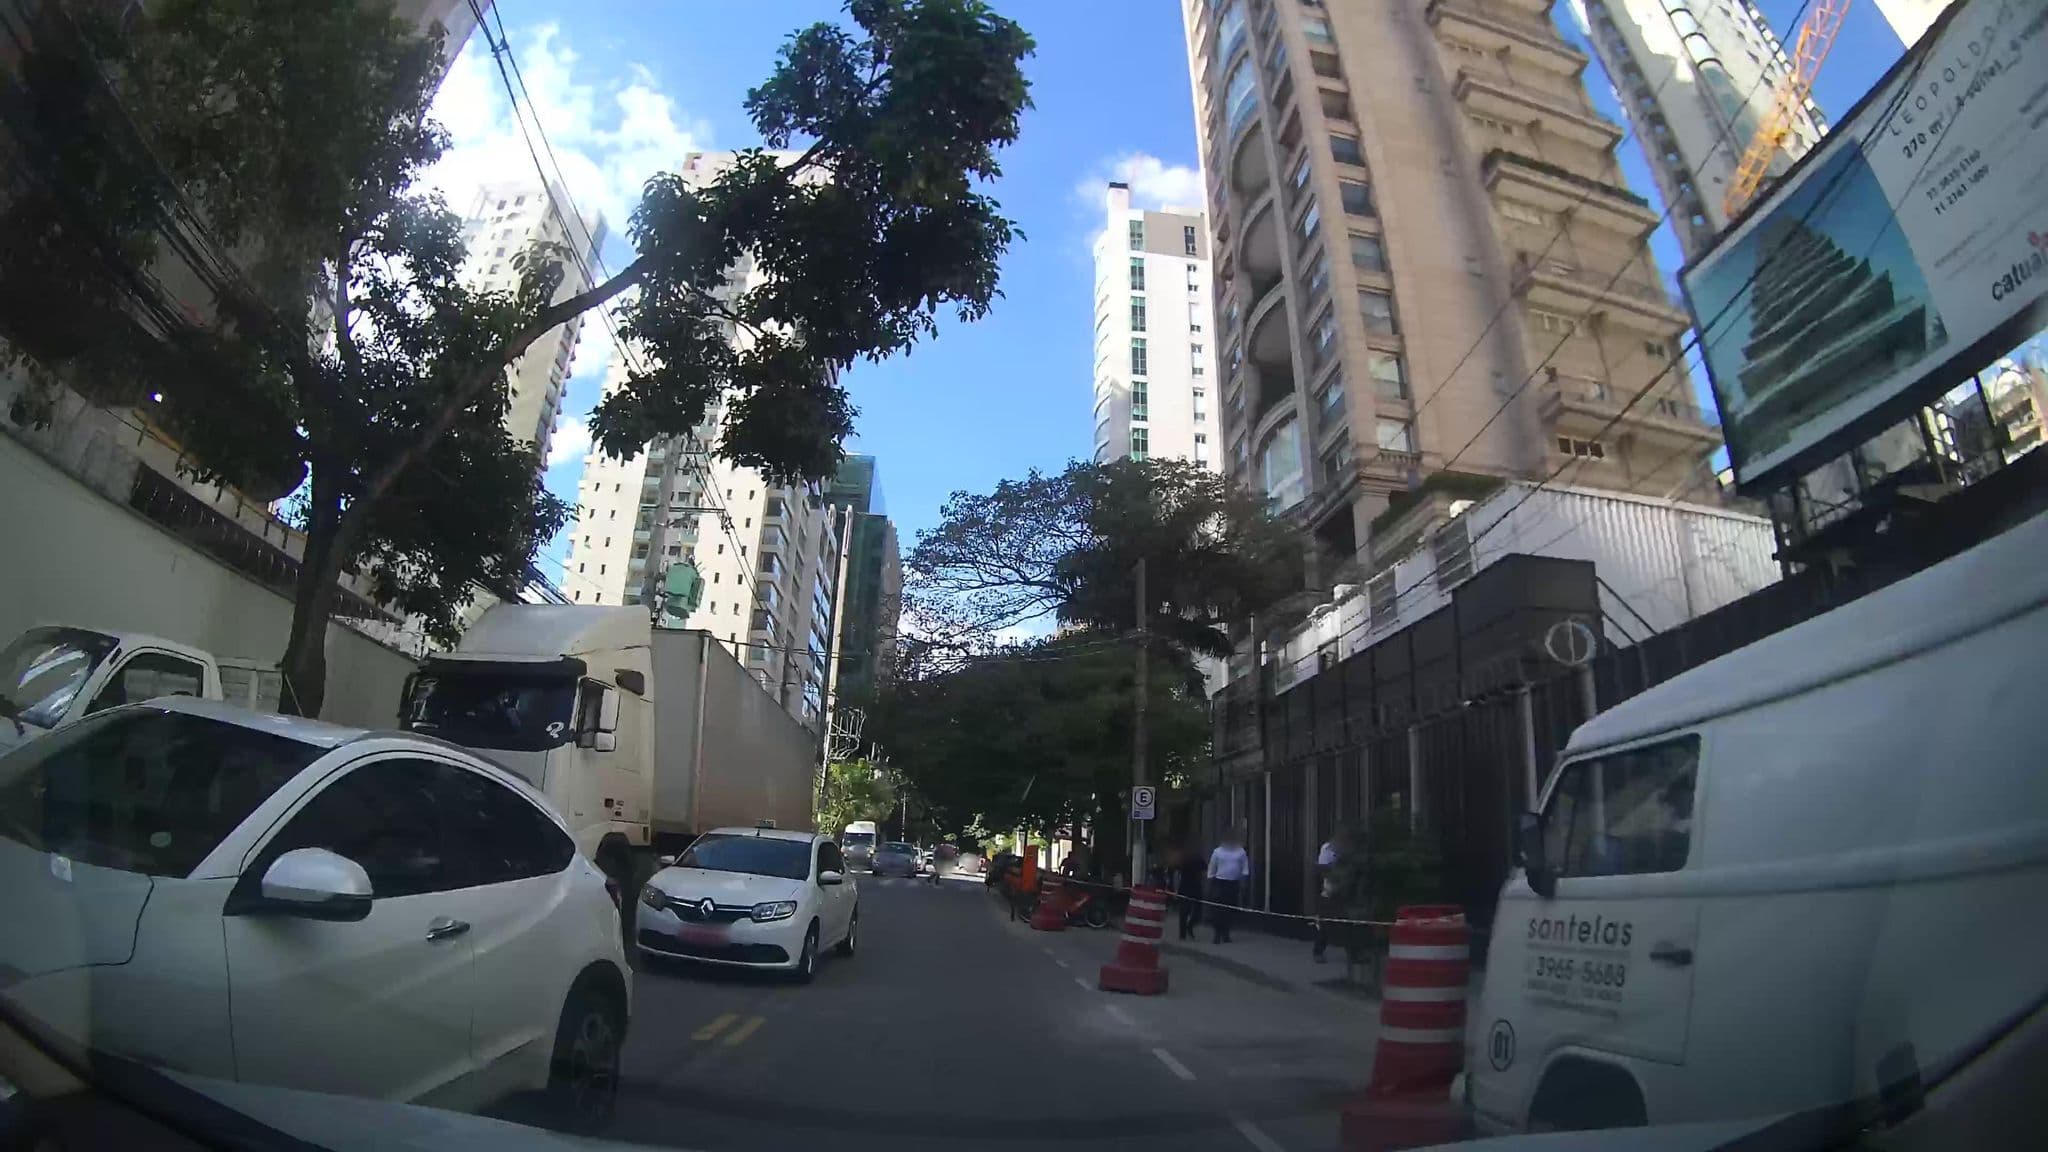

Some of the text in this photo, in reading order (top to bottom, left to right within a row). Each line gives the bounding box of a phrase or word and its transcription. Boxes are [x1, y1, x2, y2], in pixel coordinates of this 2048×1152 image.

[1902, 132, 1927, 159] 270
[1527, 914, 1633, 946] santelas
[1494, 1031, 1509, 1060] 01
